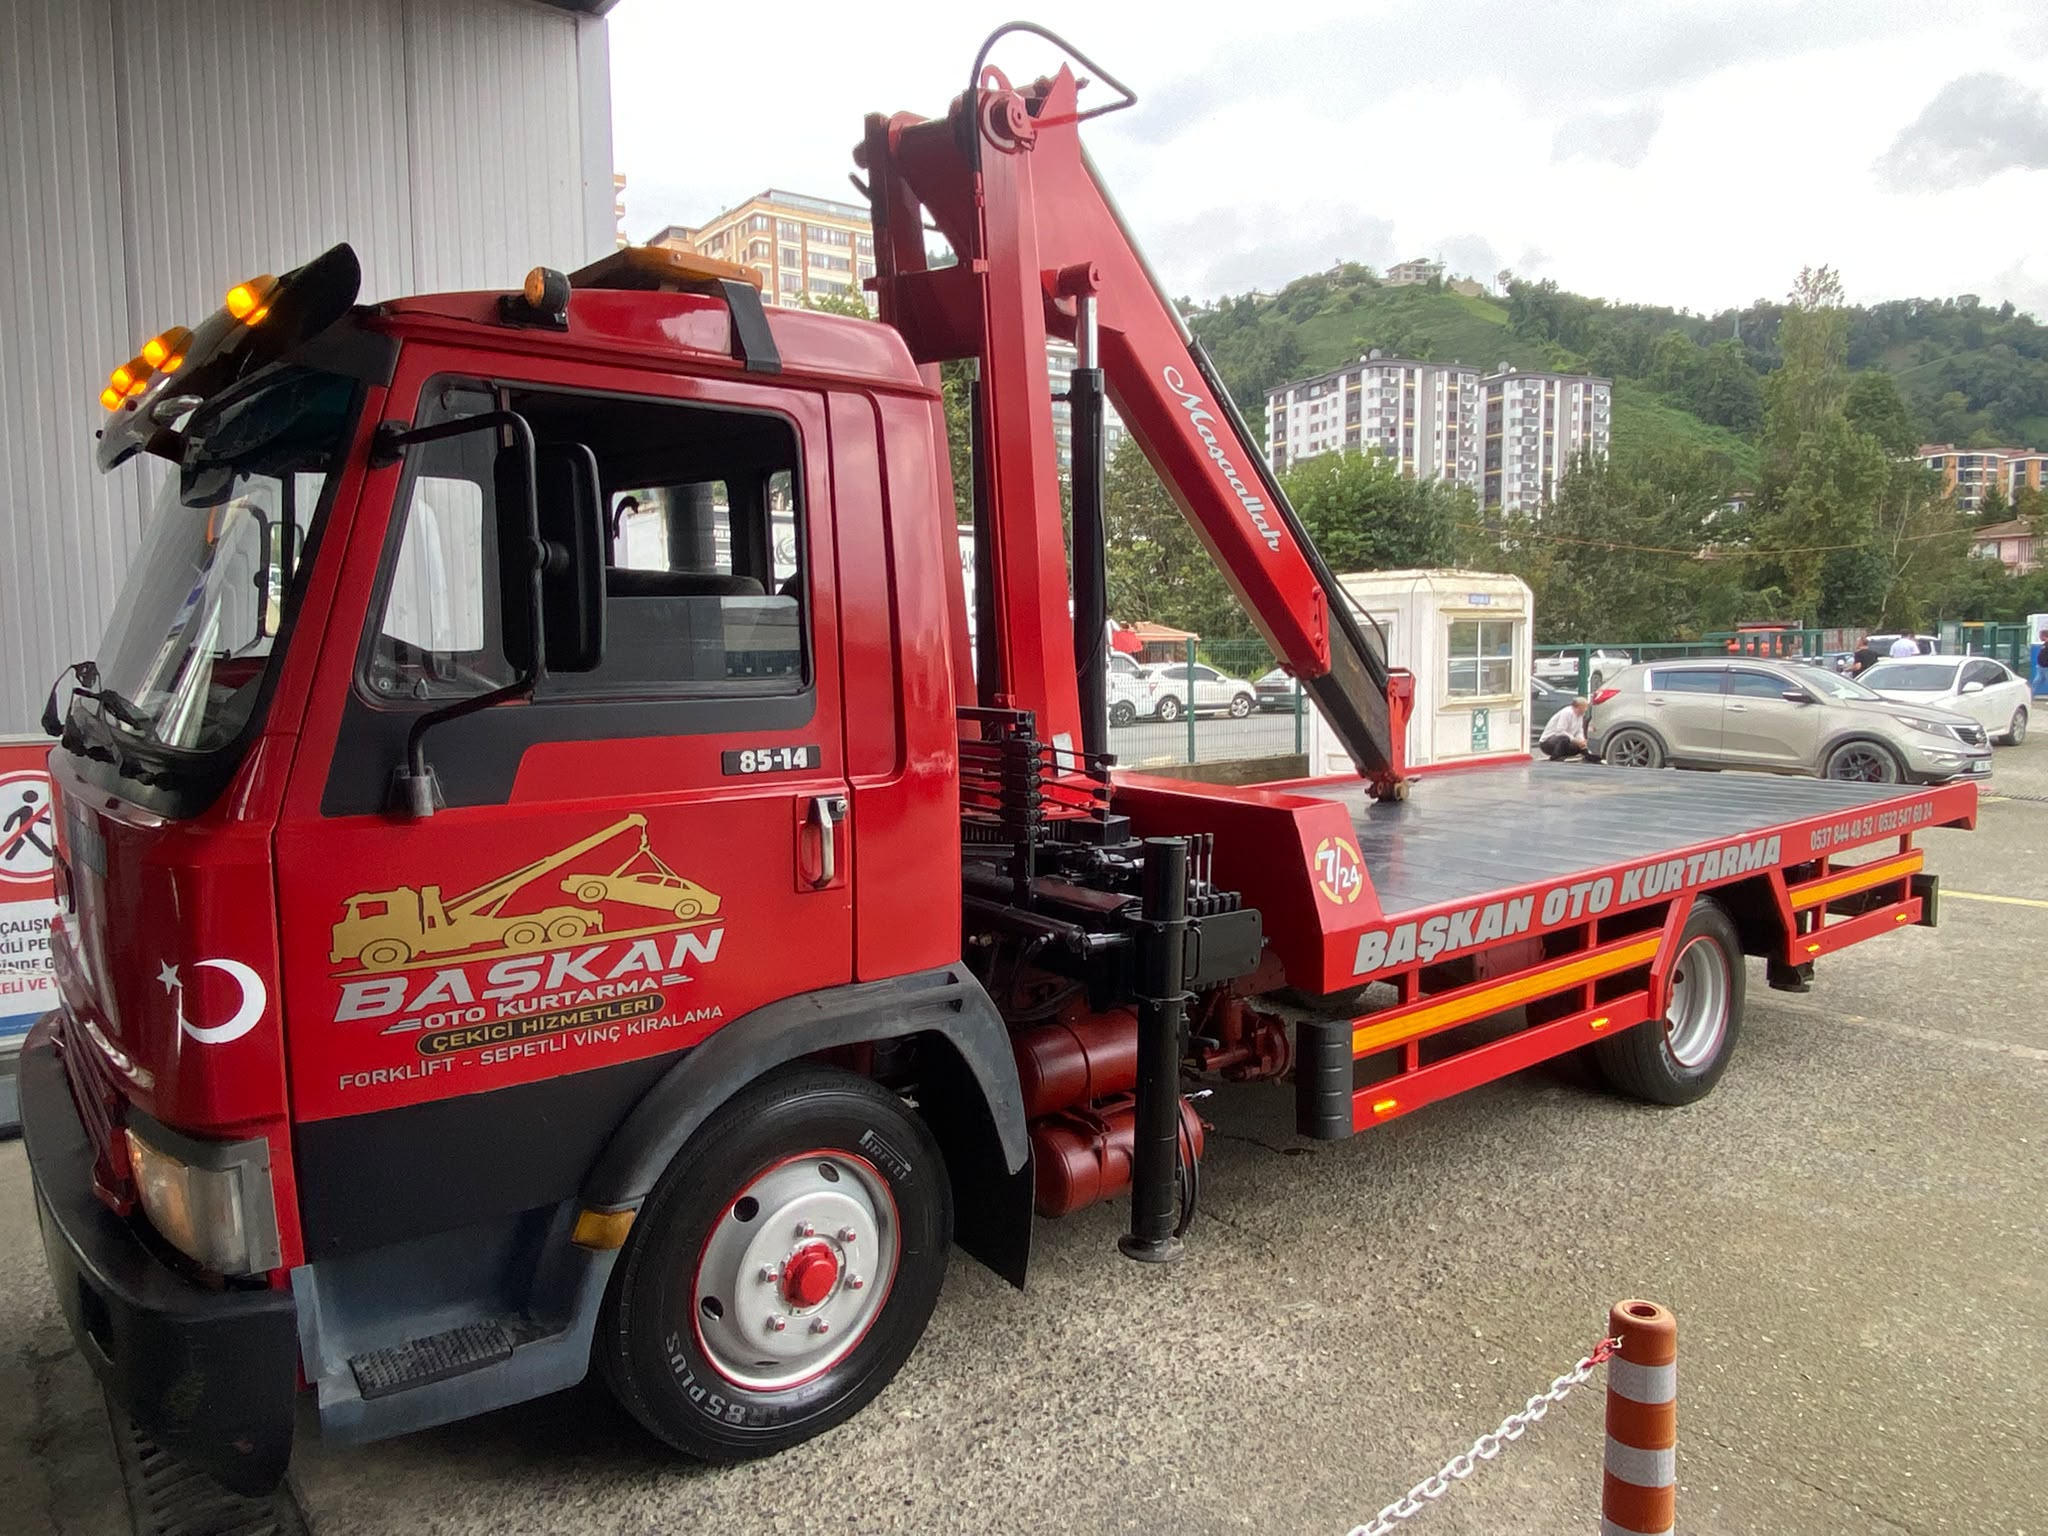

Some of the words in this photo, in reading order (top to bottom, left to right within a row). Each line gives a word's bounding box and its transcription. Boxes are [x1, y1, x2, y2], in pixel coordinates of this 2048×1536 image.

[1163, 366, 1281, 552] Maşaallah
[740, 747, 808, 773] 85-14
[1810, 827, 1832, 851] 0537
[1833, 821, 1849, 845] 844
[1862, 815, 1873, 836] 52
[1318, 846, 1360, 895] 7/24
[1352, 895, 1536, 976] BAŞKAN
[1541, 877, 1614, 926] OTO
[1620, 835, 1782, 905] KURTARMA
[0, 977, 24, 994] ELİ
[28, 977, 48, 991] VE
[333, 928, 725, 1022] BAŞKAN
[423, 1006, 486, 1030] OTO
[497, 976, 660, 1018] KURTARMA
[432, 1022, 513, 1051] ÇEKİCİ
[522, 996, 655, 1035] HİZMETLERİ
[338, 1056, 457, 1091] FORKLİFT
[480, 1033, 567, 1066] SEPETLİ
[573, 1025, 621, 1047] VİNÇ
[626, 1005, 724, 1036] KİRALAMA
